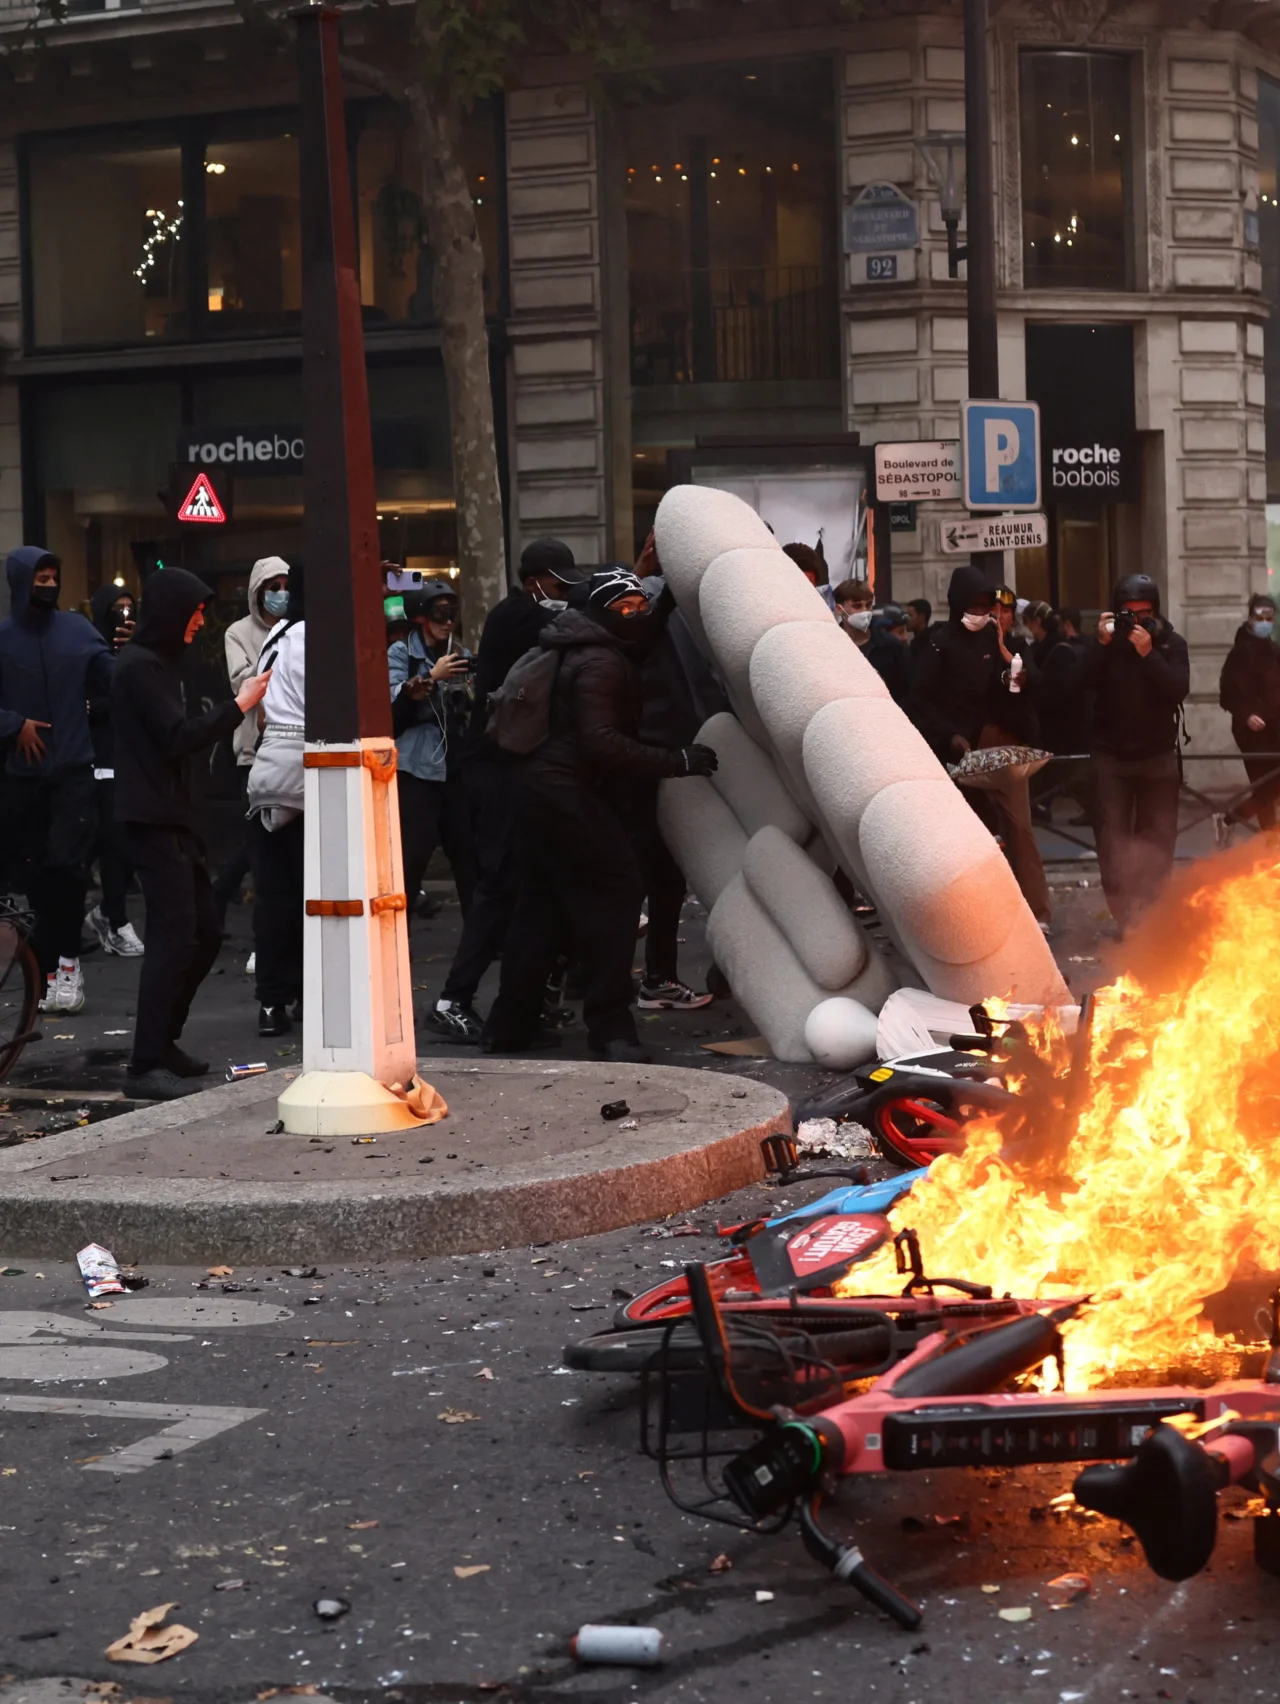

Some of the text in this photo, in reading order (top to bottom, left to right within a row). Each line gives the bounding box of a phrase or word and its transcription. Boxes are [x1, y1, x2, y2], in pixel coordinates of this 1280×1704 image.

[871, 258, 893, 276] 92
[984, 418, 1020, 493] P
[1052, 443, 1121, 464] roche
[884, 458, 954, 469] Boulevard de
[878, 472, 962, 484] SÉBASTOPOL
[1052, 465, 1120, 487] bobois
[932, 488, 941, 497] 92
[988, 522, 1033, 536] RÉAUMUR
[983, 534, 1042, 548] SAINT-DENIS
